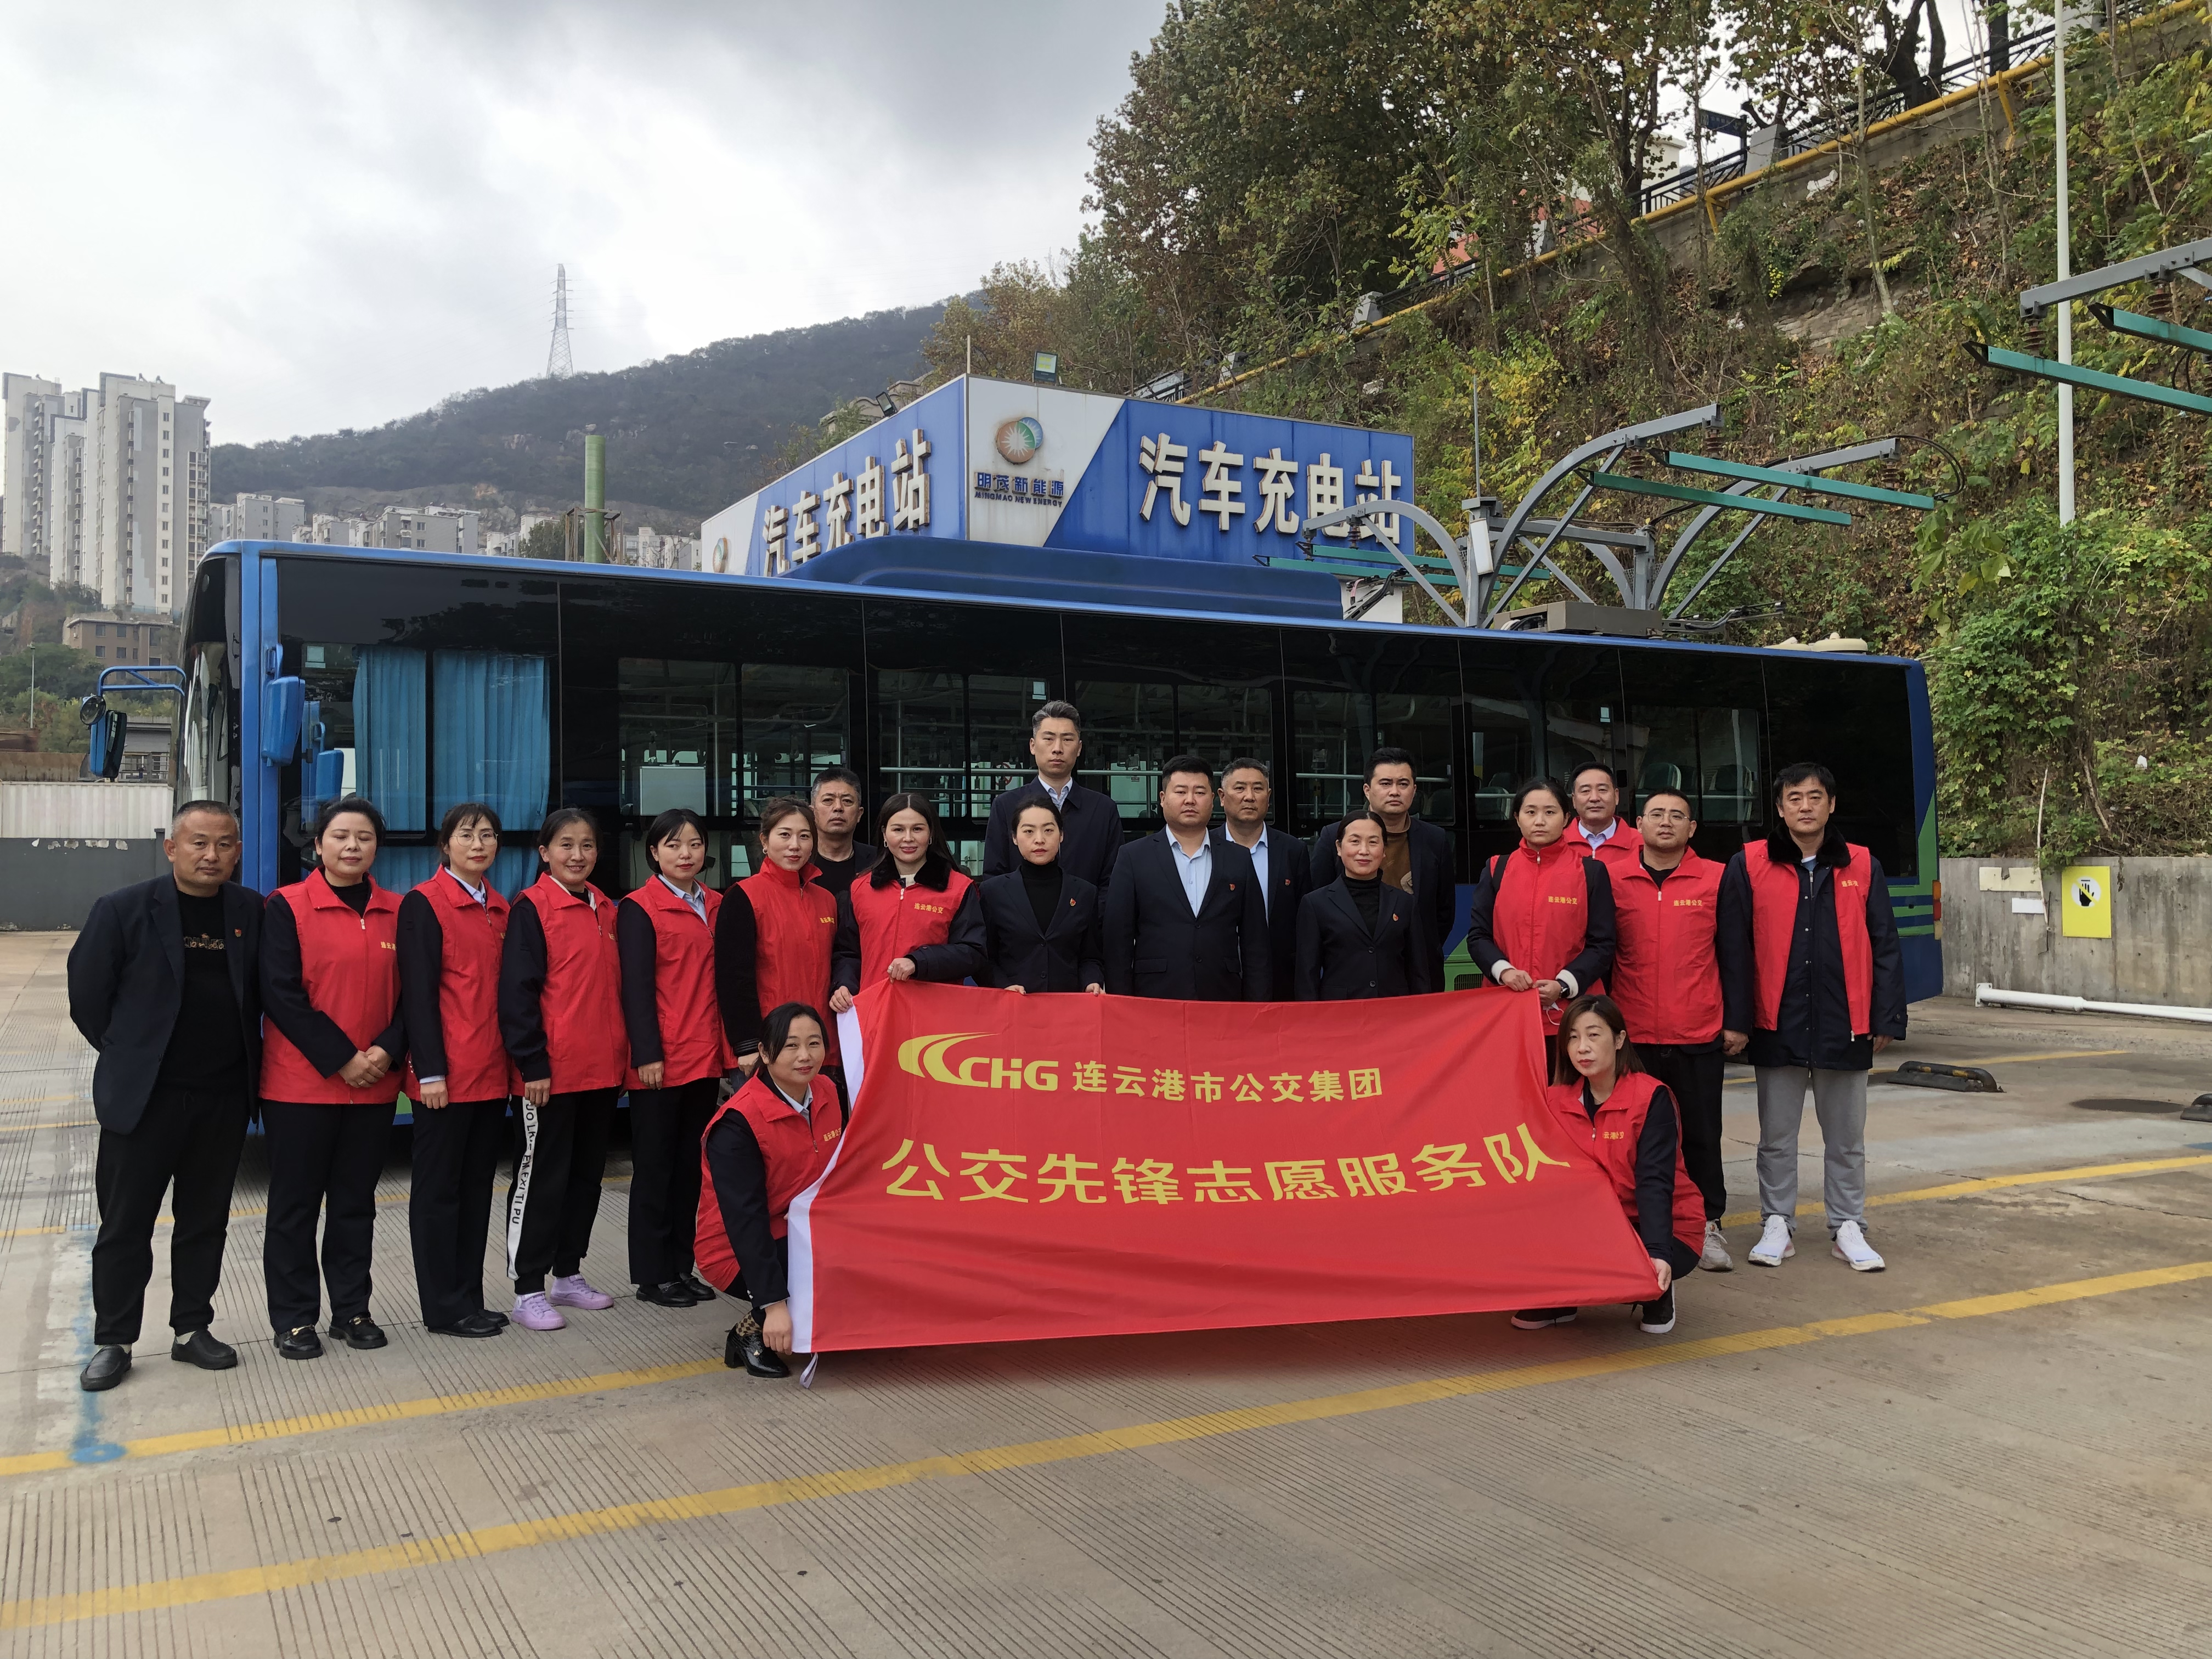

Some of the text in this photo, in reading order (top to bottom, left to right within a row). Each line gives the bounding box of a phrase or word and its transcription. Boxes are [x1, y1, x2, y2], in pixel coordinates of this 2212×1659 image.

[974, 472, 1064, 496] 明茂新能源
[974, 491, 1063, 507] MINGMAO NEW ENERGY
[1139, 432, 1401, 544] 汽车充电站
[762, 428, 931, 577] 汽车充电站
[914, 902, 944, 914] 连云港公交
[1548, 896, 1578, 905] 连云港公交
[1072, 1060, 1383, 1103] 连云港市公交集团
[882, 1122, 1571, 1205] 公交先锋志愿服务队
